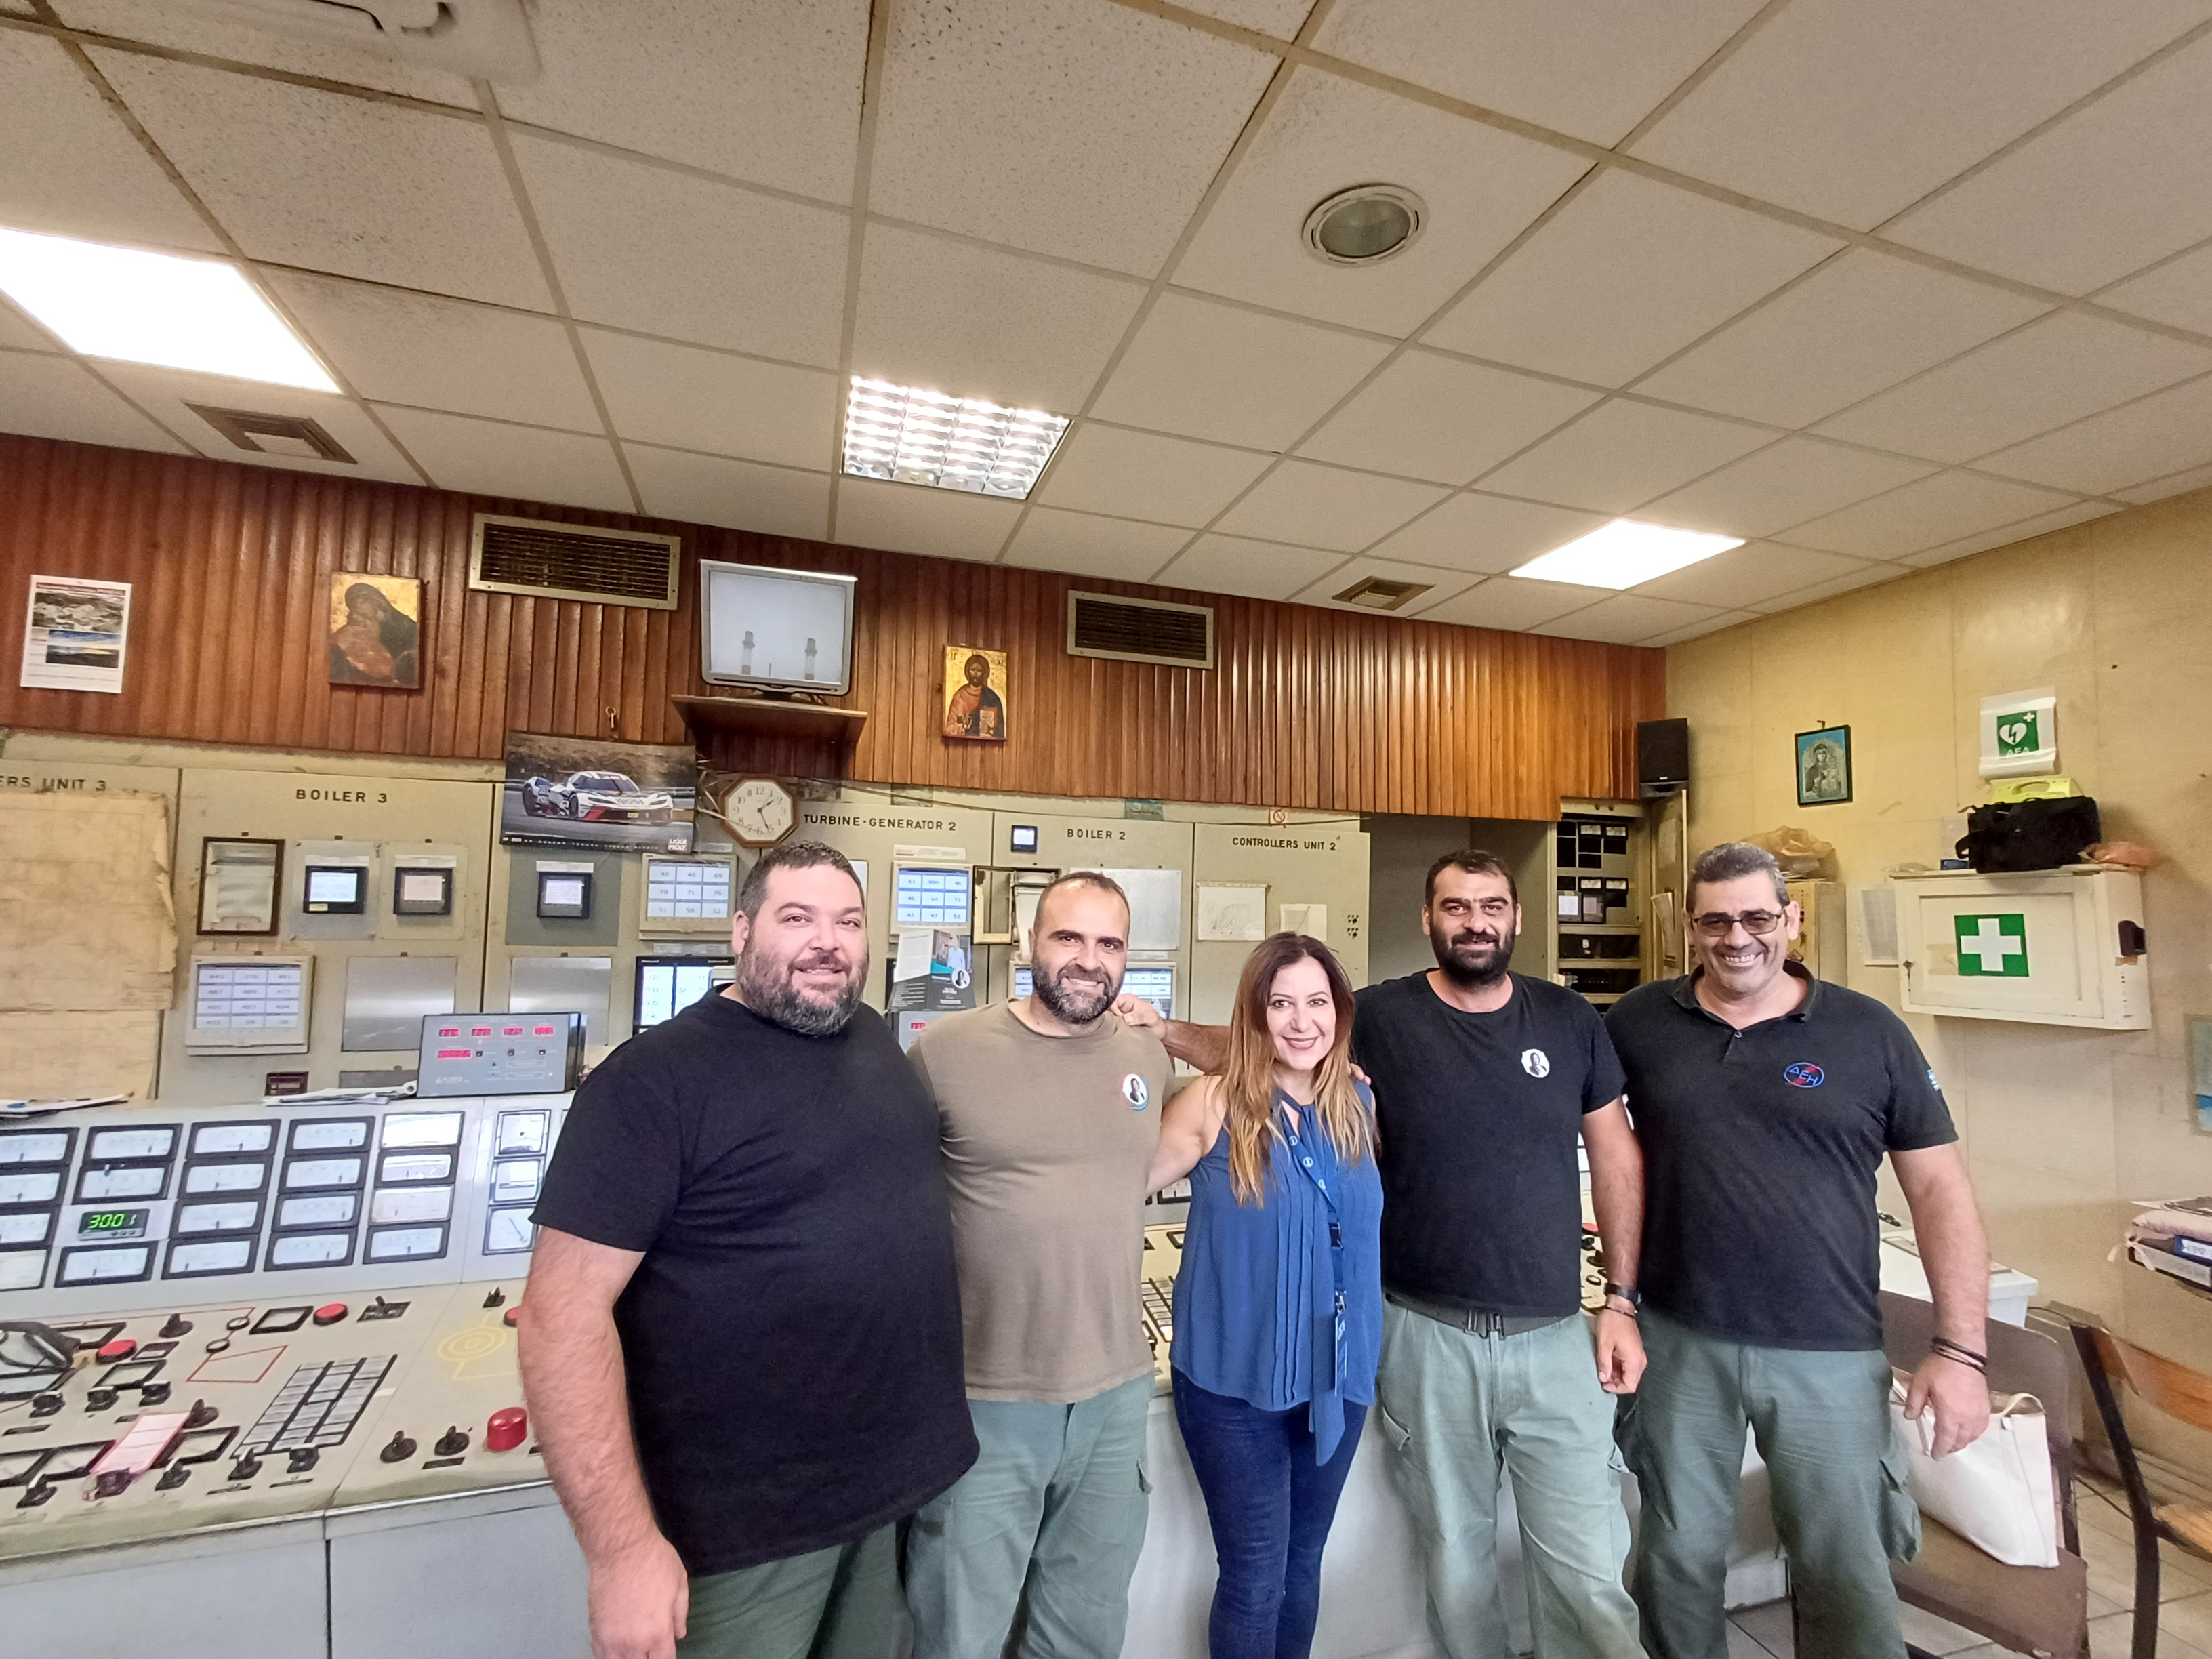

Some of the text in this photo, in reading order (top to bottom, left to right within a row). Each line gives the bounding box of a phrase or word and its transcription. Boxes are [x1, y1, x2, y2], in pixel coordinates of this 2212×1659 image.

[42, 777, 85, 790] UNIT
[96, 780, 106, 792] 3
[296, 789, 388, 803] BOILER 3
[756, 787, 765, 795] 12
[777, 797, 783, 805] 2
[948, 821, 956, 831] 2
[1067, 829, 1126, 840] BOILER 2
[1233, 837, 1336, 851] CONTROLLERS UNIT 2
[1788, 1067, 1818, 1086] ΔΕΗ
